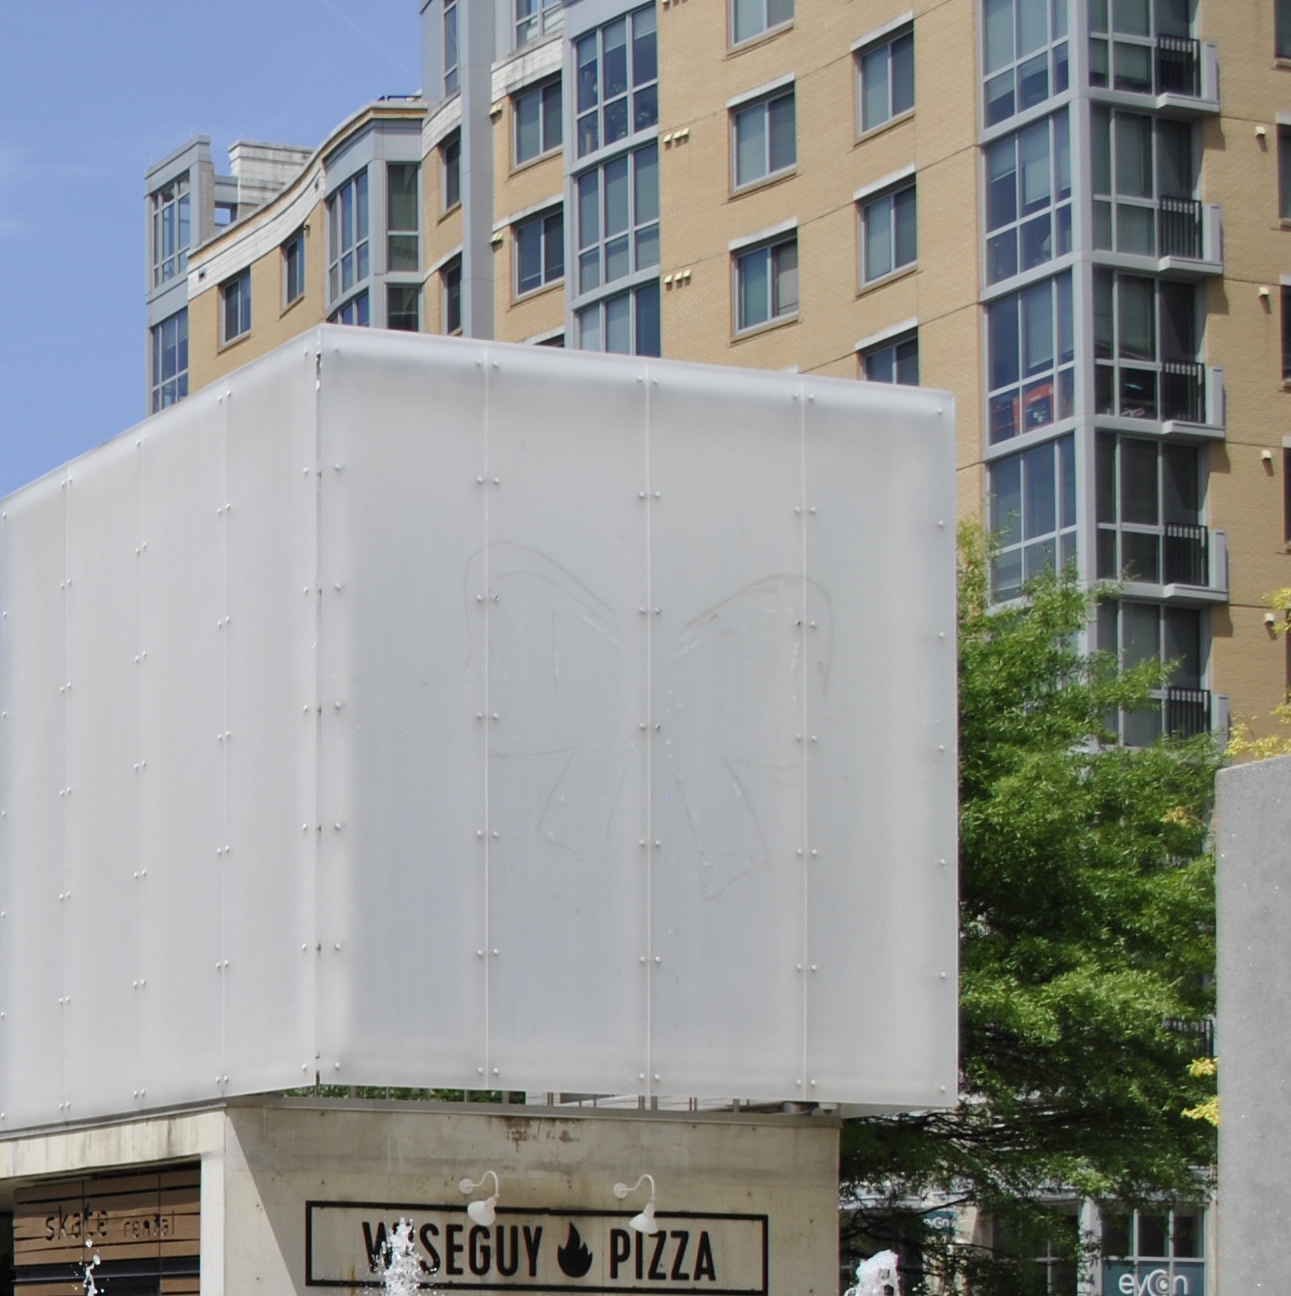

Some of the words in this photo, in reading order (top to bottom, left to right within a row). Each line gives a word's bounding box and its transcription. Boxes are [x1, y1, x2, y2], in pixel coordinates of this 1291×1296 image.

[45, 1203, 108, 1241] skate
[123, 1209, 175, 1238] rental
[362, 1221, 543, 1278] WSEGUY
[610, 1228, 716, 1281] PIZZA
